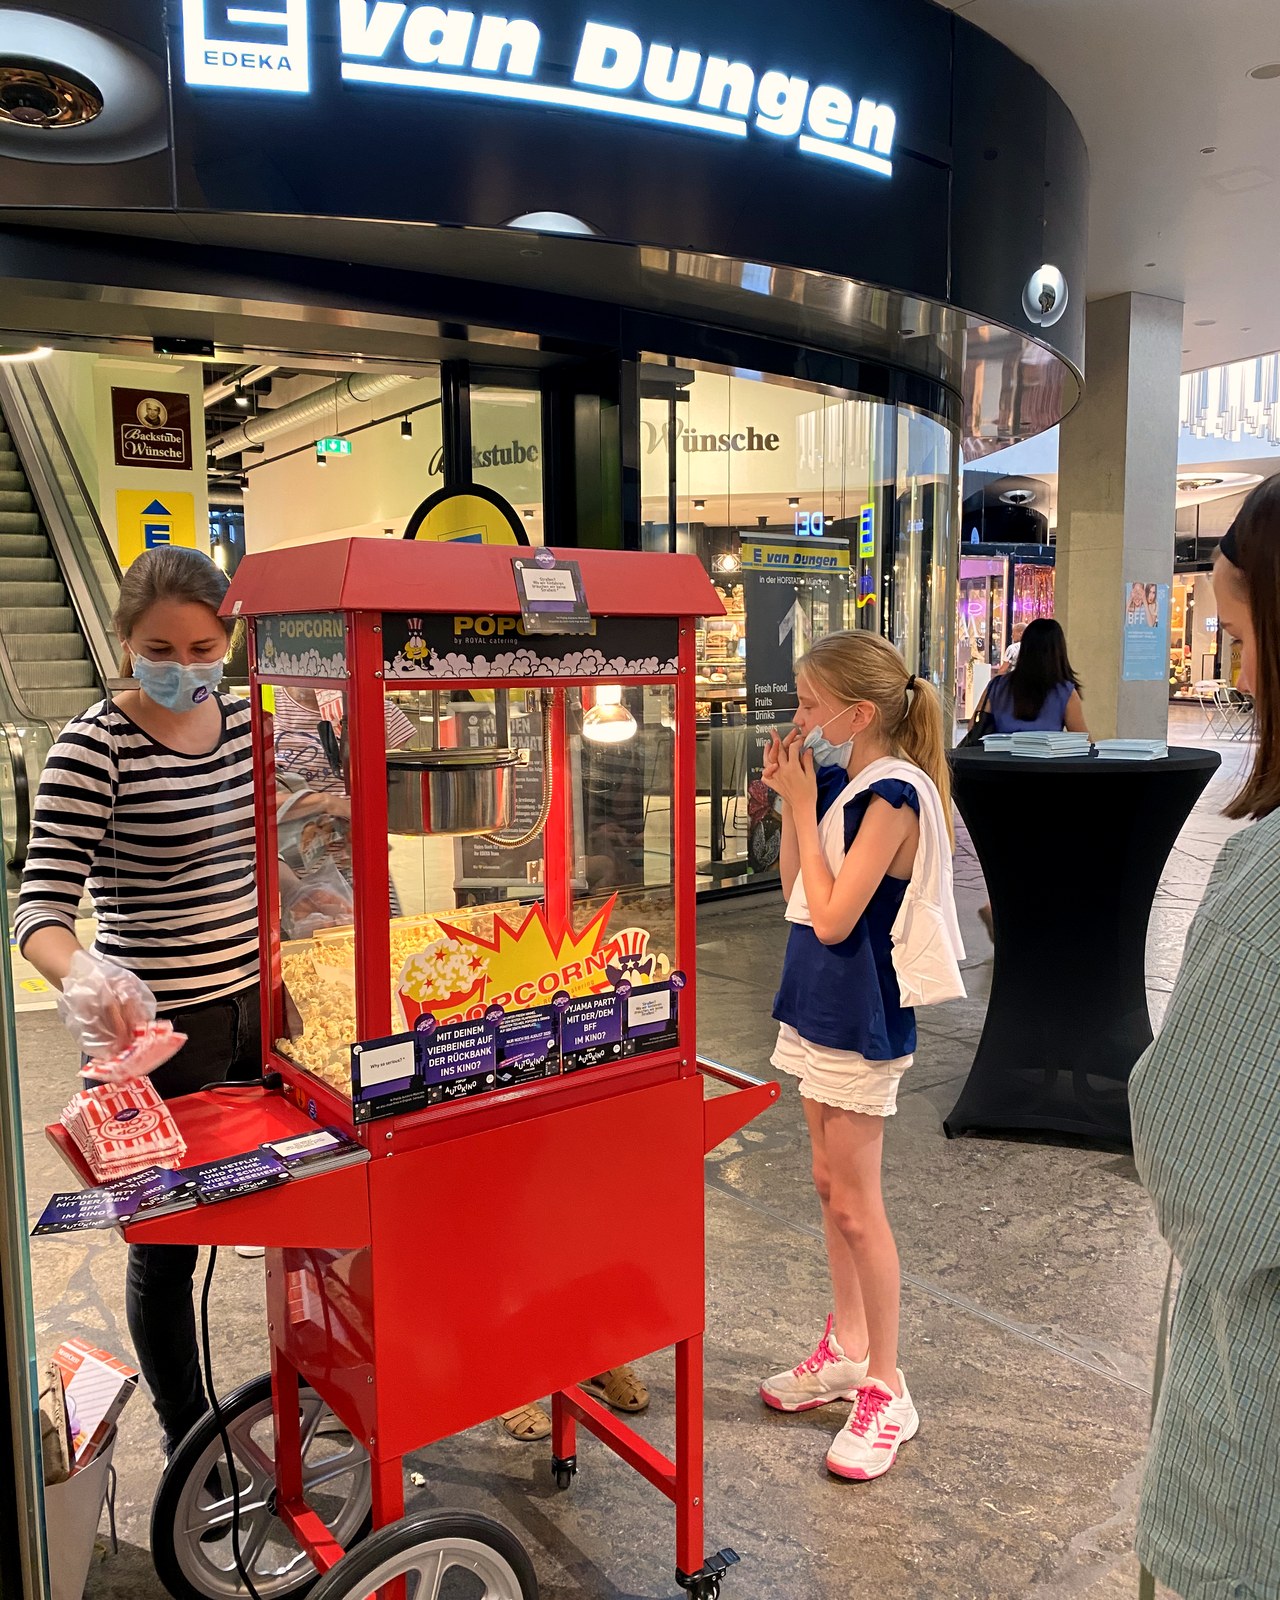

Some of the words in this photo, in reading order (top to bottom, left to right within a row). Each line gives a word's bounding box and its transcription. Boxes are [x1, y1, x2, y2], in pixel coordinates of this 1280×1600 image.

[204, 51, 292, 72] EDEKA
[339, 0, 541, 76] van
[573, 21, 896, 154] Dungen
[124, 428, 182, 444] Backstube
[640, 417, 779, 454] Wünsche
[124, 441, 182, 458] Wünsche
[766, 553, 790, 564] van
[793, 553, 838, 567] Dungen
[766, 576, 776, 584] der
[776, 577, 802, 585] HOFSTAT
[1128, 612, 1145, 625] BFF
[279, 619, 343, 638] POPCORN
[754, 684, 771, 694] Fresh
[772, 683, 788, 693] Food
[755, 697, 773, 707] Fruits
[755, 711, 775, 720] Drinks
[483, 718, 531, 734] KUDEN
[593, 997, 617, 1008] PARTY
[566, 1014, 580, 1025] MIT
[581, 1008, 614, 1021] DER/DEM
[436, 1031, 452, 1042] MIT
[454, 1025, 484, 1039] DEINEM
[583, 1022, 597, 1032] BFF
[427, 1038, 476, 1056] VIERBEINER
[477, 1034, 493, 1045] AUF
[574, 1037, 584, 1045] IM
[584, 1031, 606, 1043] KINO?
[429, 1056, 446, 1067] DER
[447, 1046, 492, 1063] RÜCKBANK
[513, 1055, 545, 1070] AUTOKINO
[577, 1050, 605, 1064] AUTOKINO
[440, 1066, 455, 1077] INS
[456, 1060, 482, 1073] KINO?
[444, 1080, 477, 1096] AUTOKINO
[199, 1167, 218, 1176] AUF
[220, 1156, 260, 1170] NETFLIX
[203, 1171, 226, 1179] UND
[228, 1162, 261, 1173] PRIME-
[123, 1174, 162, 1189] R/DEM
[126, 1169, 156, 1183] PARTY
[200, 1181, 231, 1191] ALLES
[232, 1166, 282, 1183] GESEHEN?
[203, 1174, 235, 1184] VIDEO
[56, 1193, 99, 1202] PYJAMA
[101, 1189, 137, 1197] PARTY
[142, 1184, 166, 1197] INO?
[78, 1196, 130, 1206] DER/DEM
[60, 1219, 106, 1230] AUTOKINO
